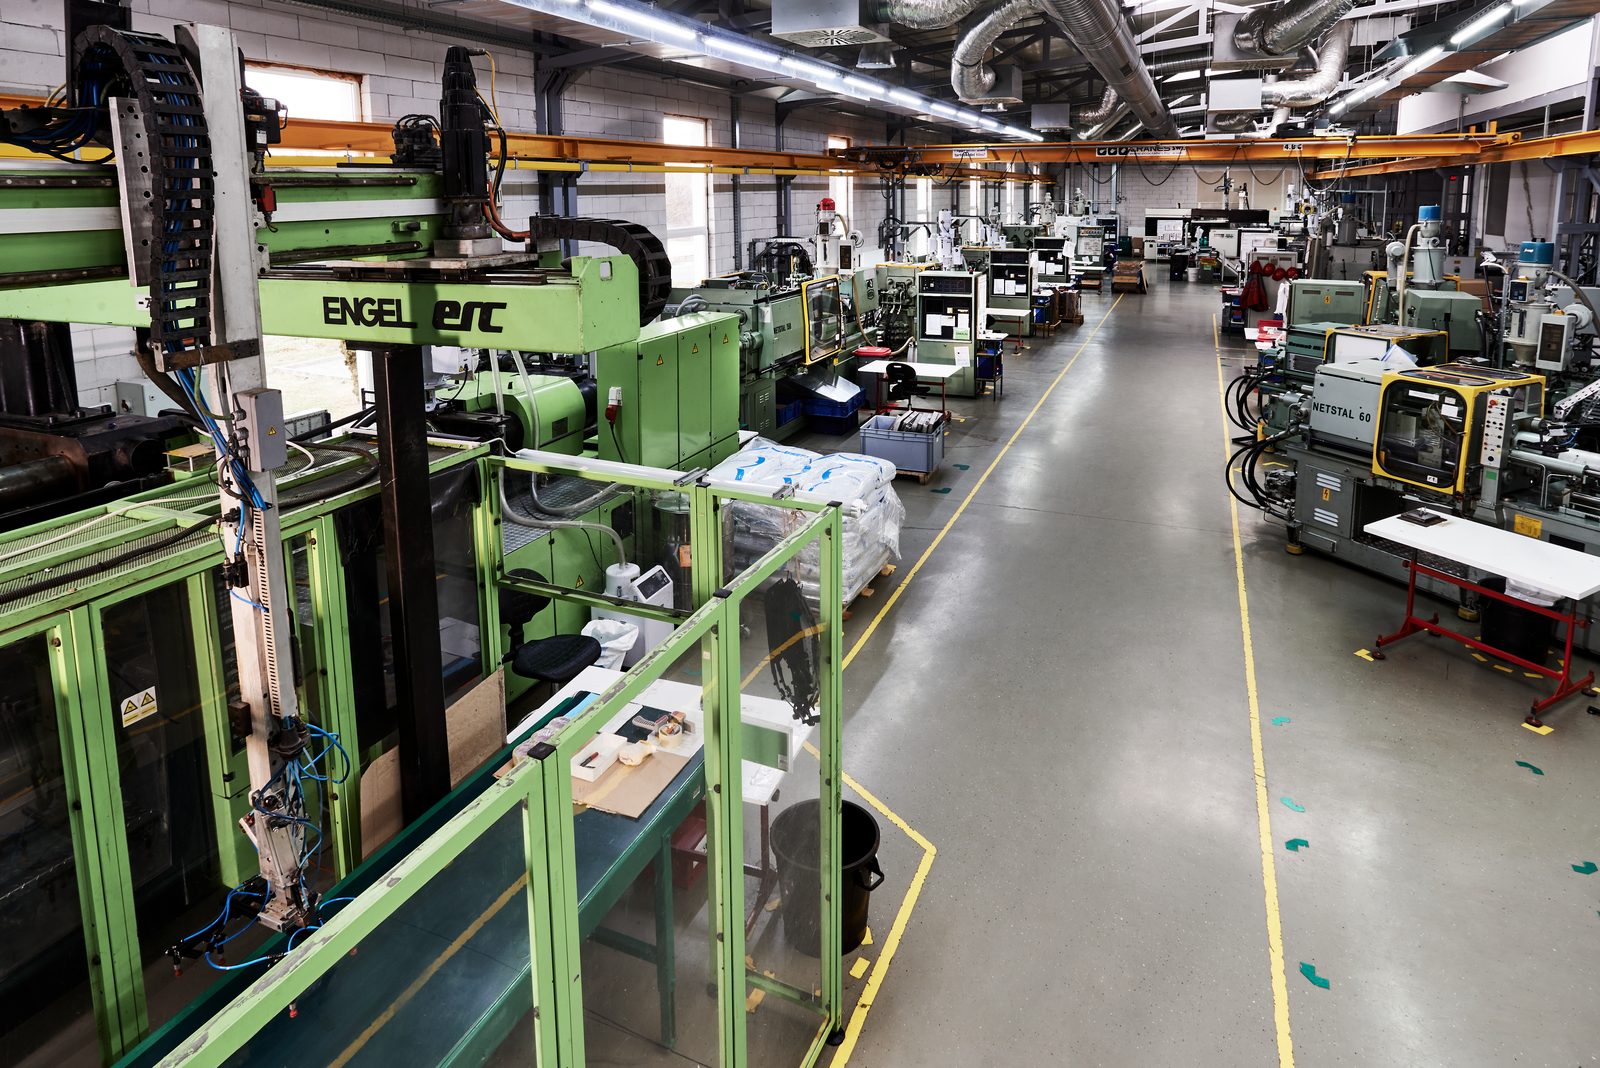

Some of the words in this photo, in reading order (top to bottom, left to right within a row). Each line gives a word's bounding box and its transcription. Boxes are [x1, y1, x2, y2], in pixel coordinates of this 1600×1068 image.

[322, 296, 418, 329] ENGEL
[432, 300, 507, 333] erc
[1312, 401, 1355, 419] NETSTAL
[1359, 411, 1371, 422] 60
